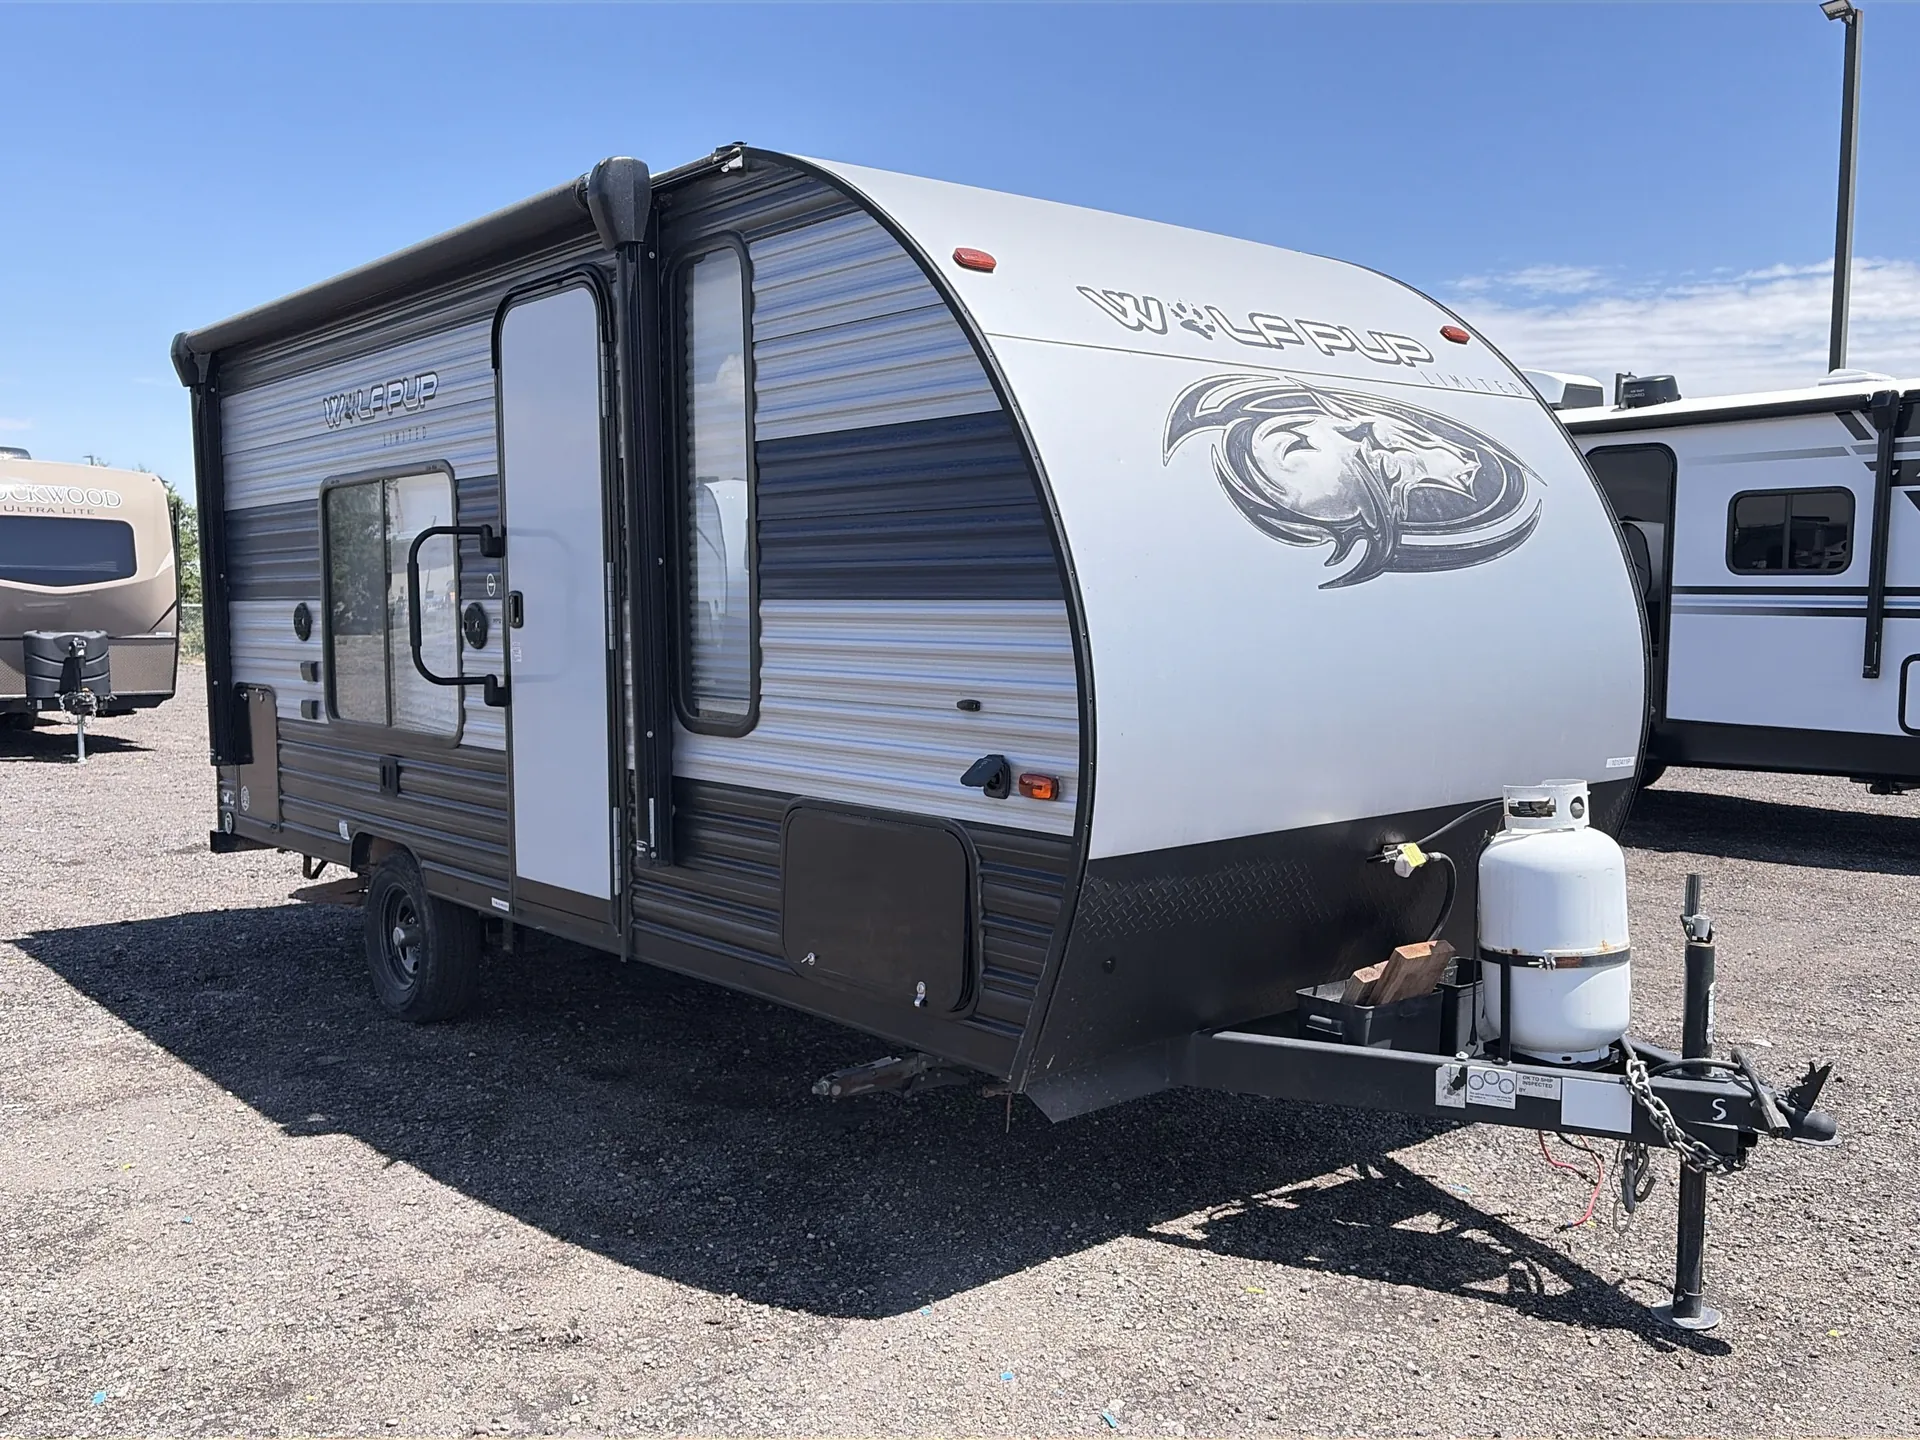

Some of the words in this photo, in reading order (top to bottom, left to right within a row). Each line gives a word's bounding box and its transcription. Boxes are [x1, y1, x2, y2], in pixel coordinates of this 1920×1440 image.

[1294, 318, 1435, 368] PUP
[386, 371, 439, 416] PUP
[1420, 370, 1523, 395] LIMITED
[3, 505, 56, 514] ULTRA
[62, 507, 96, 516] LITE
[1522, 1080, 1554, 1089] INSPECTED
[1712, 1098, 1727, 1121] S
